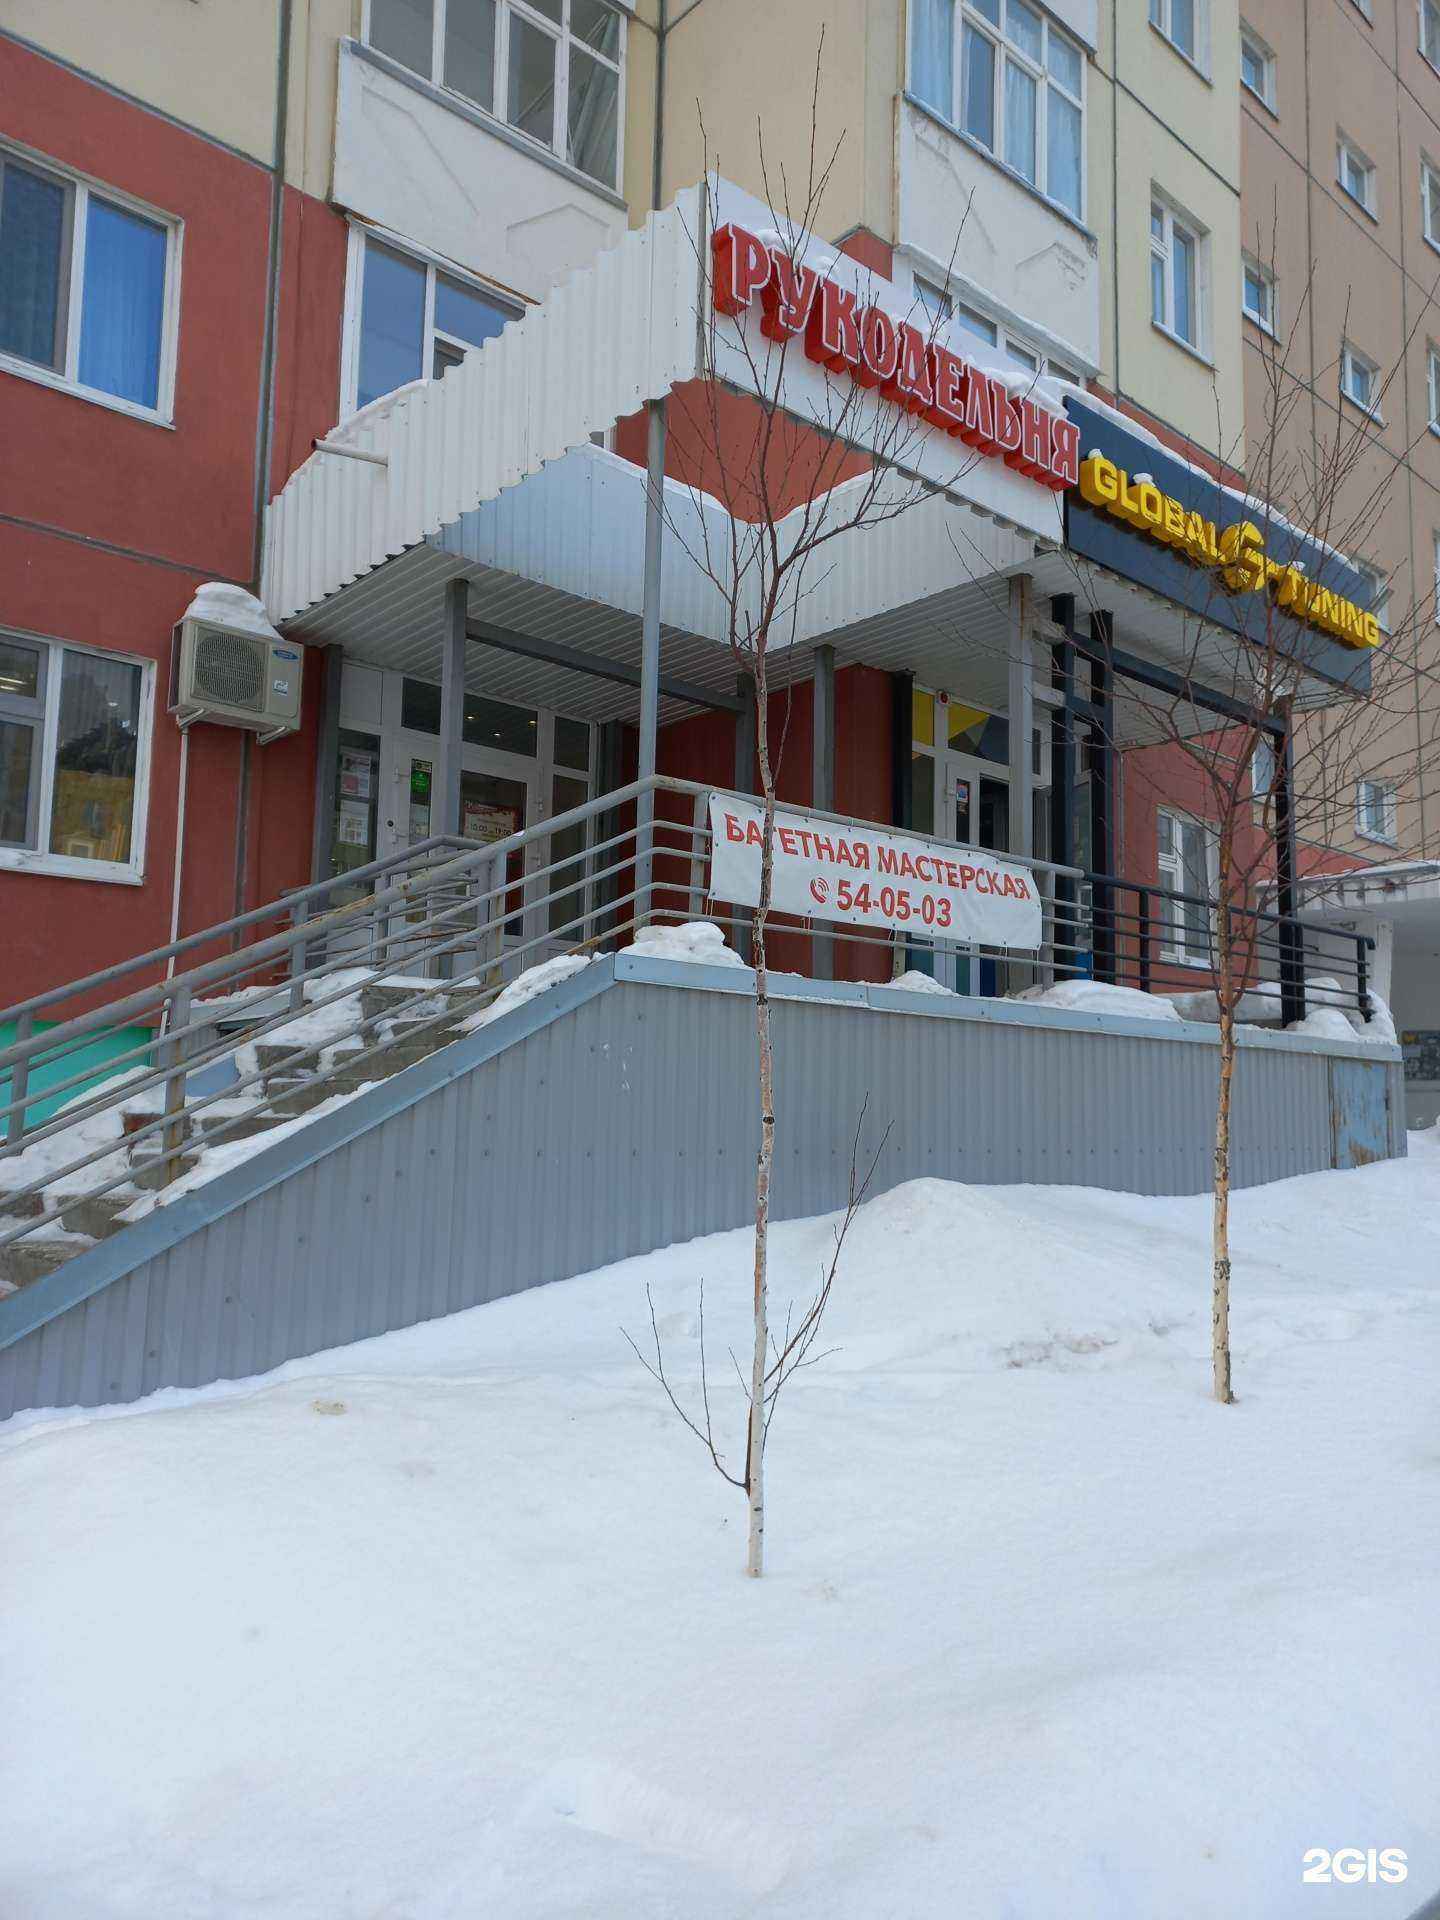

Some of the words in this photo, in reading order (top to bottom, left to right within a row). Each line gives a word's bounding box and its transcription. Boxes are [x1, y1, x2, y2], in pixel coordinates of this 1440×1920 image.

[711, 222, 1081, 492] РУКОДЕЛЬНЯ
[724, 813, 870, 870] БАЕТНАЯ
[876, 845, 1031, 900] МАСТЕРСКАЯ
[836, 879, 952, 928] 54-05-03
